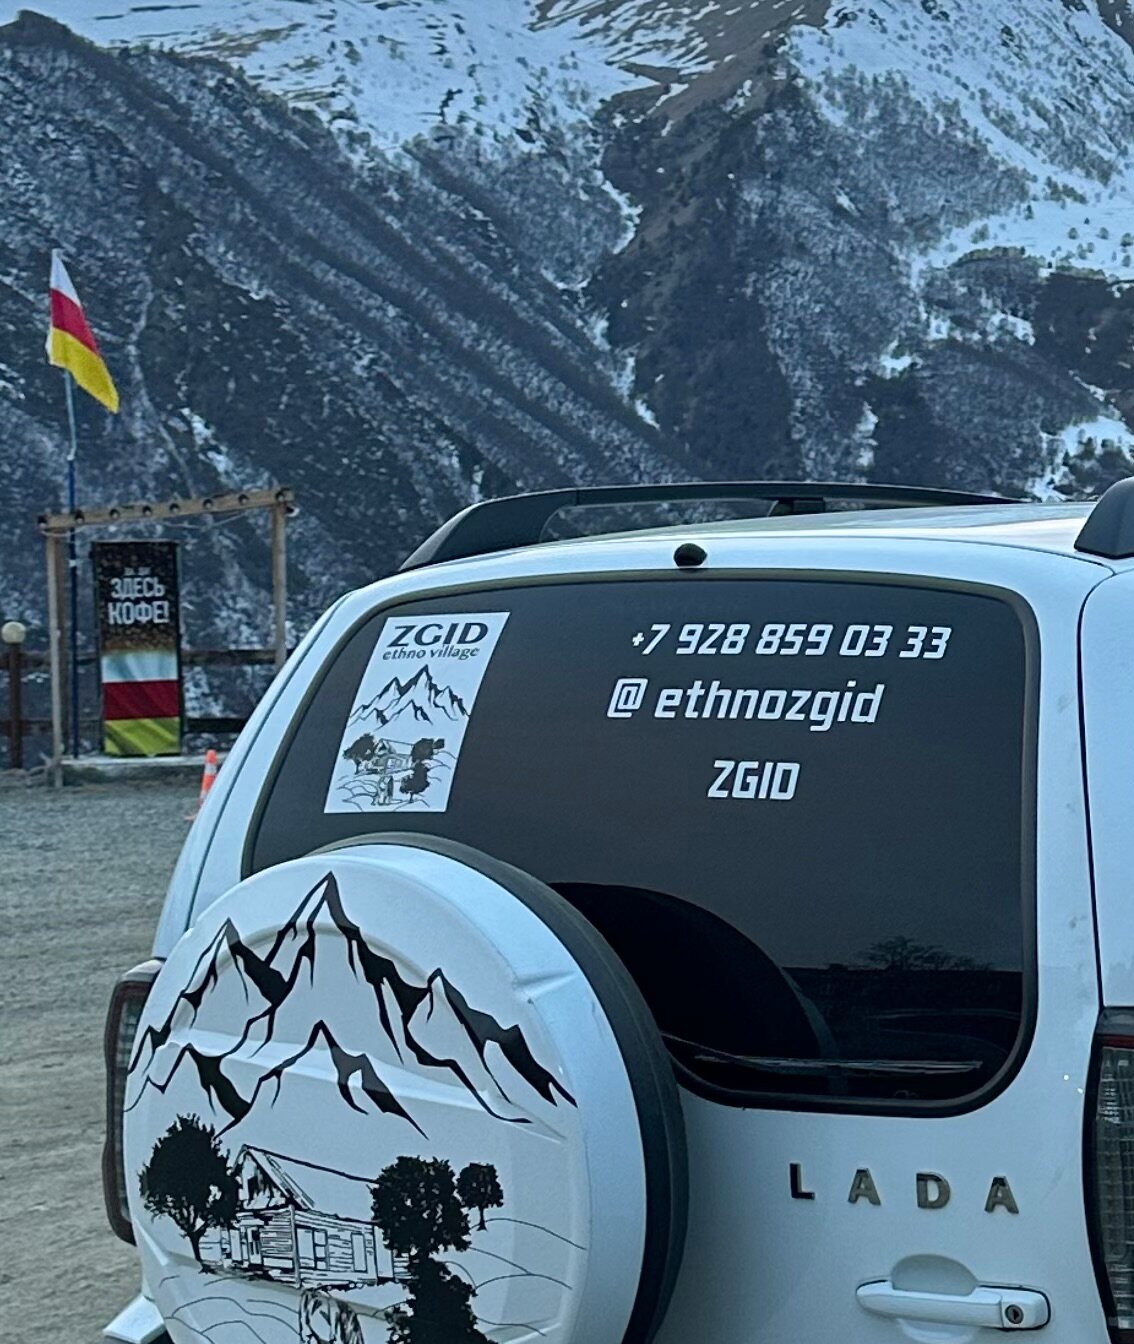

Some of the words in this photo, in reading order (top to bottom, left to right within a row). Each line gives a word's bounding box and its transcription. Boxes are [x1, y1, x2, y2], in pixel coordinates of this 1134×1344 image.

[110, 576, 166, 600] ЗДЕСЬ
[108, 600, 170, 625] КОФЕ!
[387, 622, 489, 648] ZGID
[632, 624, 670, 655] +7
[676, 624, 750, 655] 928
[755, 624, 834, 656] 859
[839, 625, 893, 657] 03
[899, 626, 952, 659] 33
[382, 646, 426, 661] ethno
[430, 644, 480, 661] village
[707, 760, 800, 800] ZGID
[789, 1163, 1019, 1214] LADA
